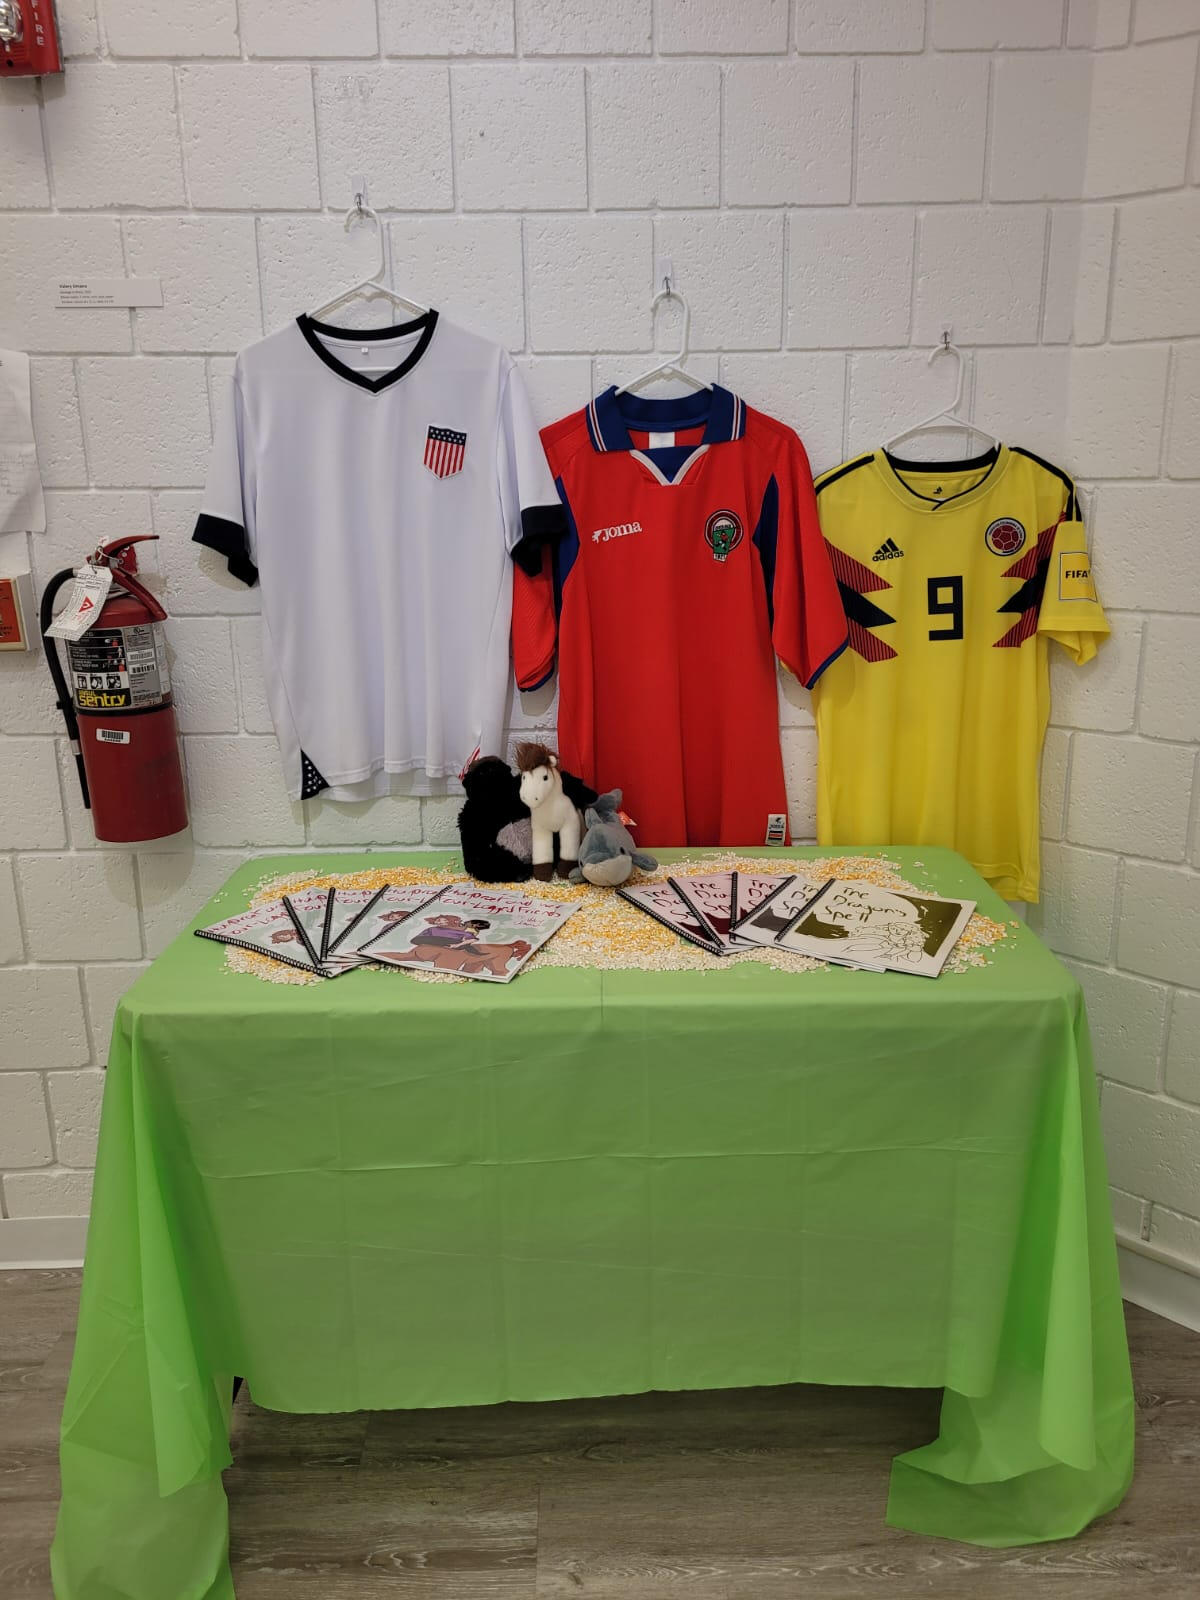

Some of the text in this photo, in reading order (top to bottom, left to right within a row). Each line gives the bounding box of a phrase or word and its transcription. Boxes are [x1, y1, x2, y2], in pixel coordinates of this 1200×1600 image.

[31, 0, 45, 46] FIRE
[872, 549, 905, 562] adidas
[1065, 570, 1088, 579] FIFA
[927, 575, 963, 641] 9
[844, 886, 869, 899] The
[825, 905, 869, 922] Spell
